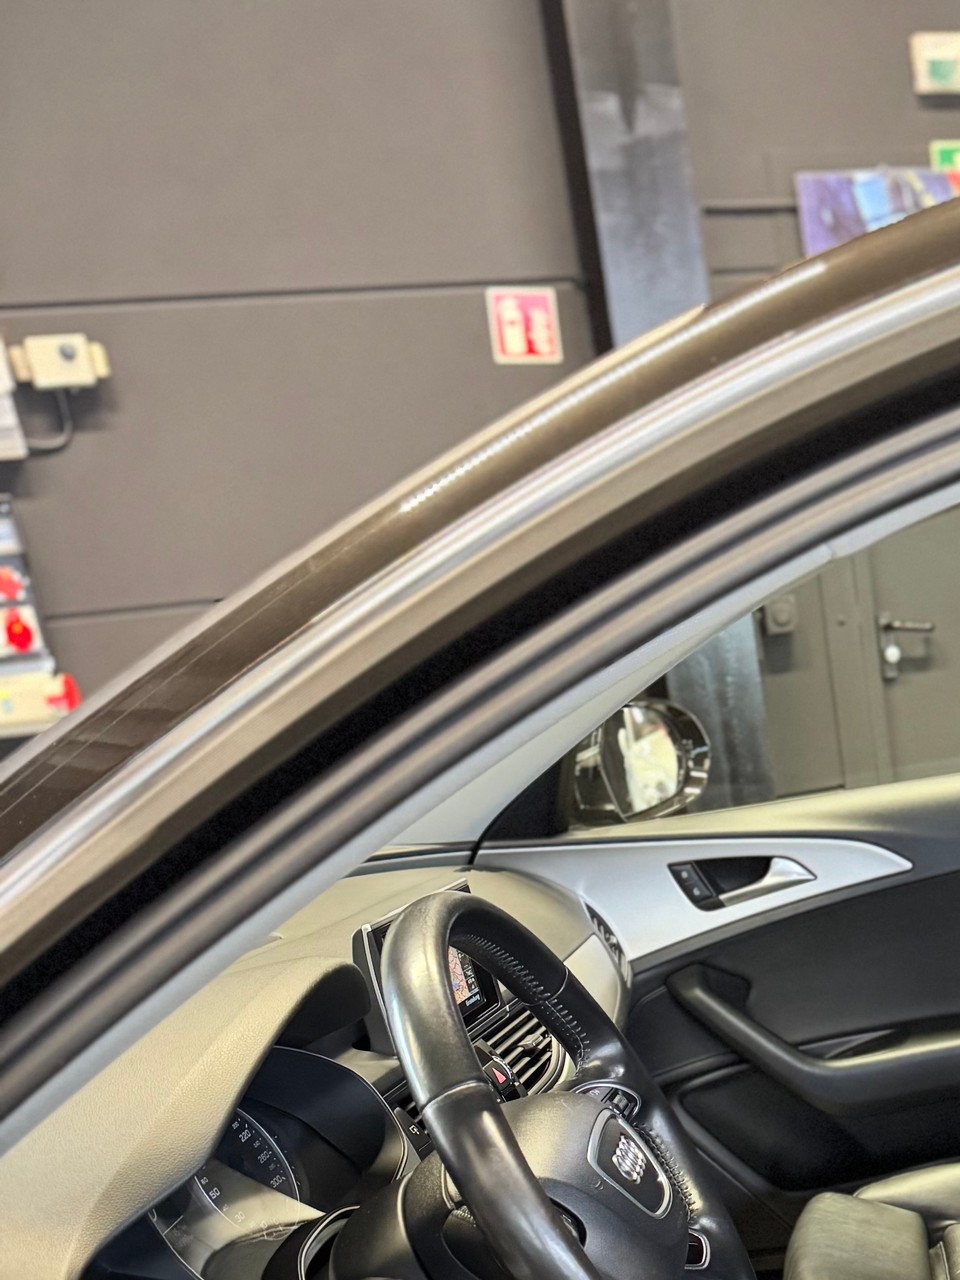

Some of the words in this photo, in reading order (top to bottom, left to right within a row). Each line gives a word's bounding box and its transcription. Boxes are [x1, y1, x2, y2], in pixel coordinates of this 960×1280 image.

[238, 1129, 251, 1142] 220
[257, 1150, 270, 1163] 260
[270, 1175, 283, 1188] 300
[208, 1187, 221, 1199] 50
[234, 1211, 246, 1223] 30
